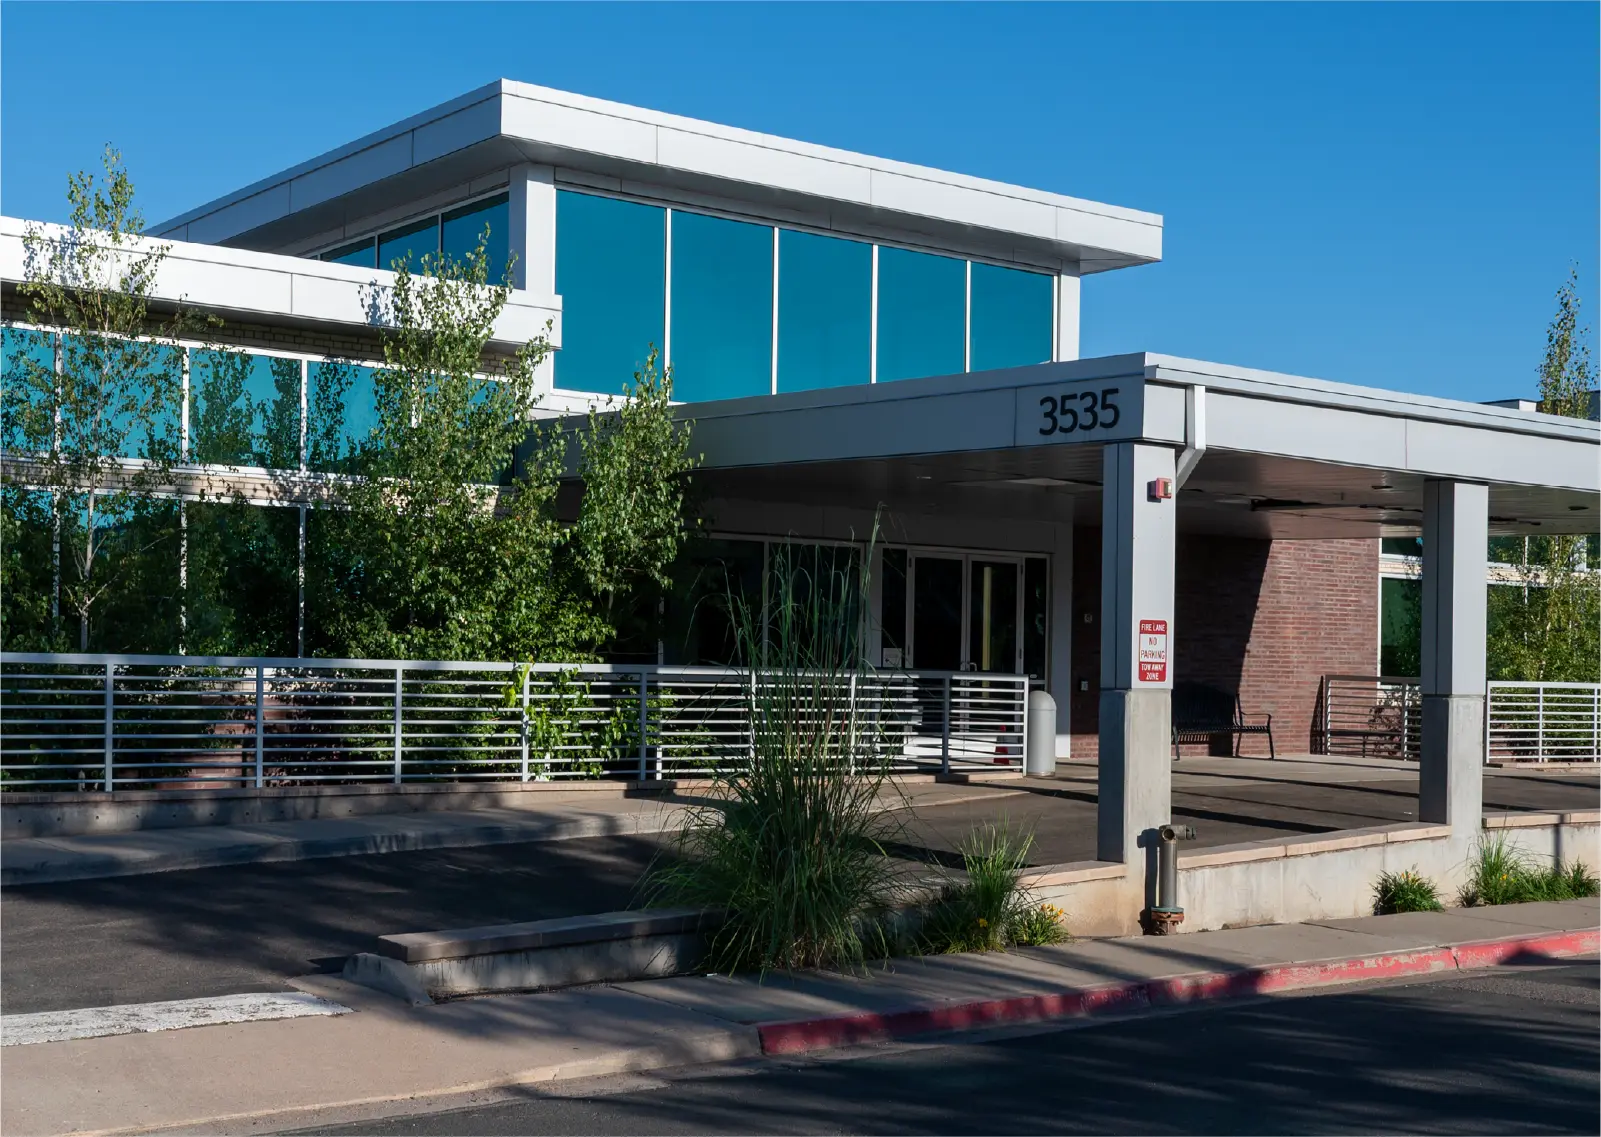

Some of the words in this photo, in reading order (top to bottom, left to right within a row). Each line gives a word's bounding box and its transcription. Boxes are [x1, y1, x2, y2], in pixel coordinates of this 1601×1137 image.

[1039, 388, 1120, 436] 3535
[1148, 636, 1158, 646] NO
[1141, 650, 1165, 660] PARKING
